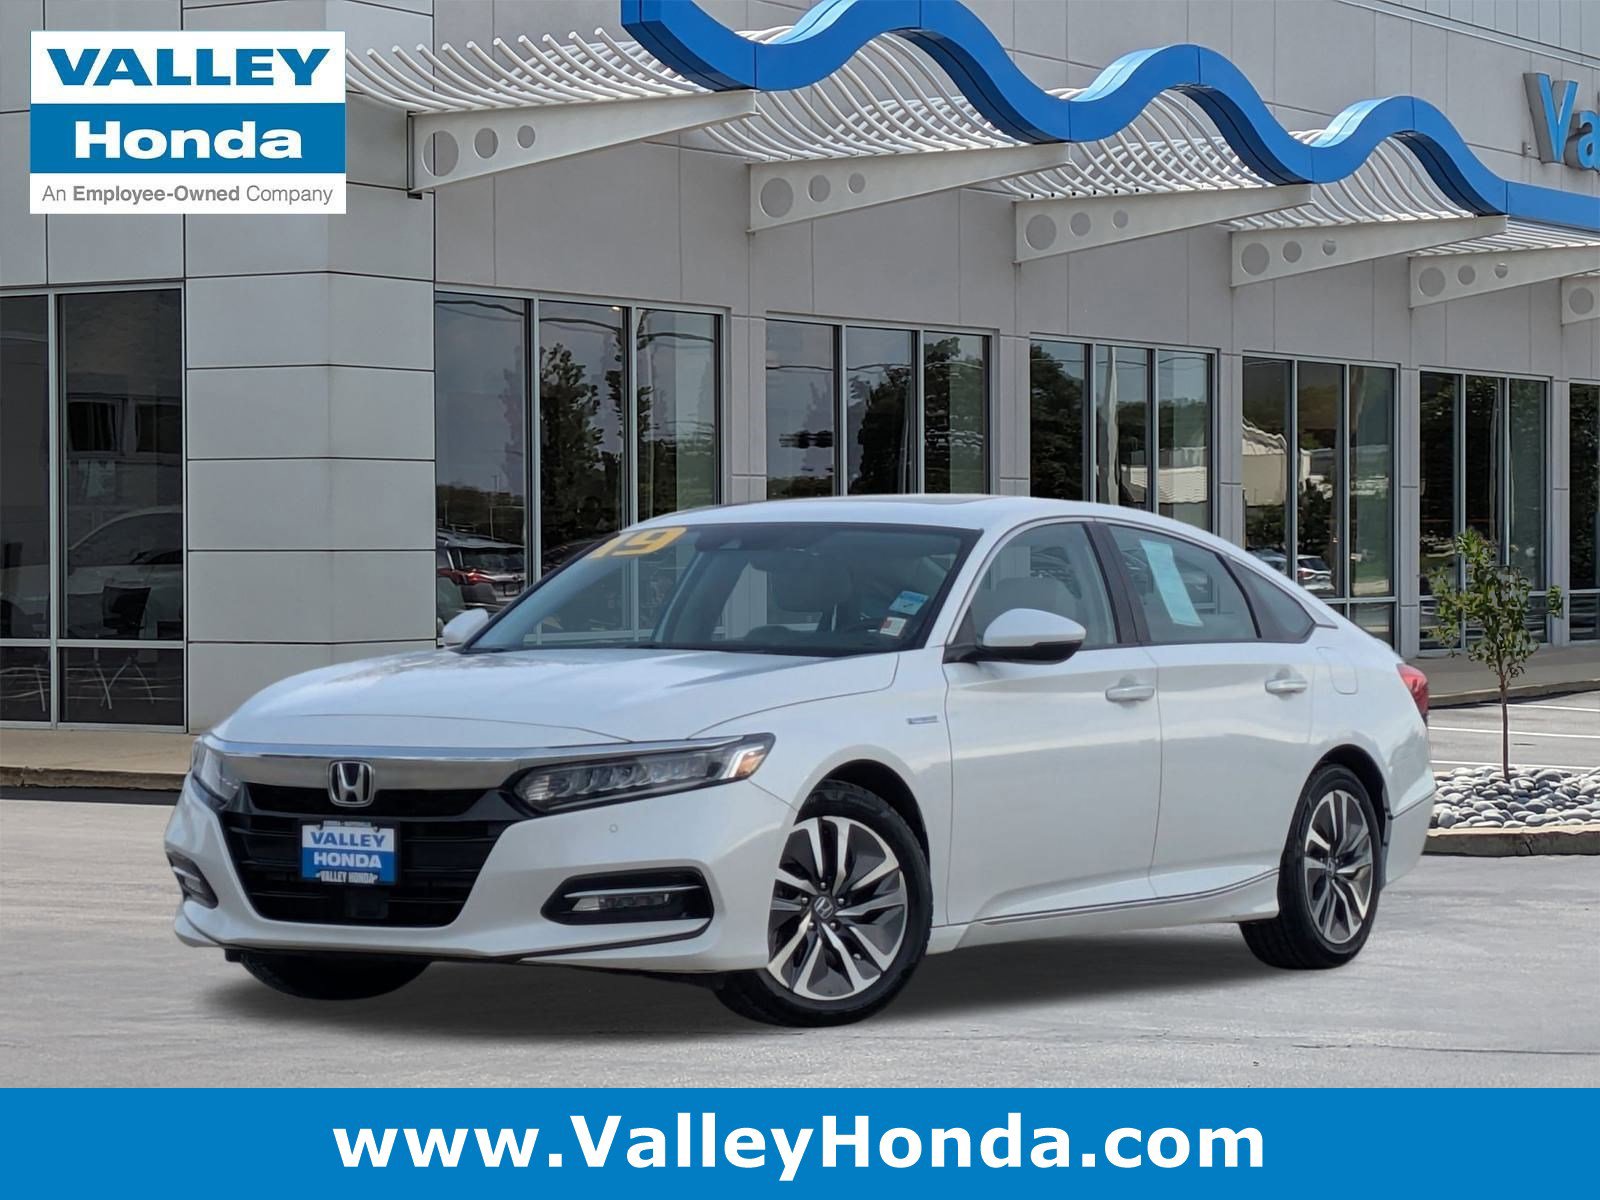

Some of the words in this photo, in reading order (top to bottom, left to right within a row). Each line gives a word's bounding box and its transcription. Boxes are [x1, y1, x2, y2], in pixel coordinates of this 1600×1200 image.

[310, 831, 386, 848] VALLEY
[313, 851, 382, 869] HONDA
[320, 870, 347, 884] VALLEY
